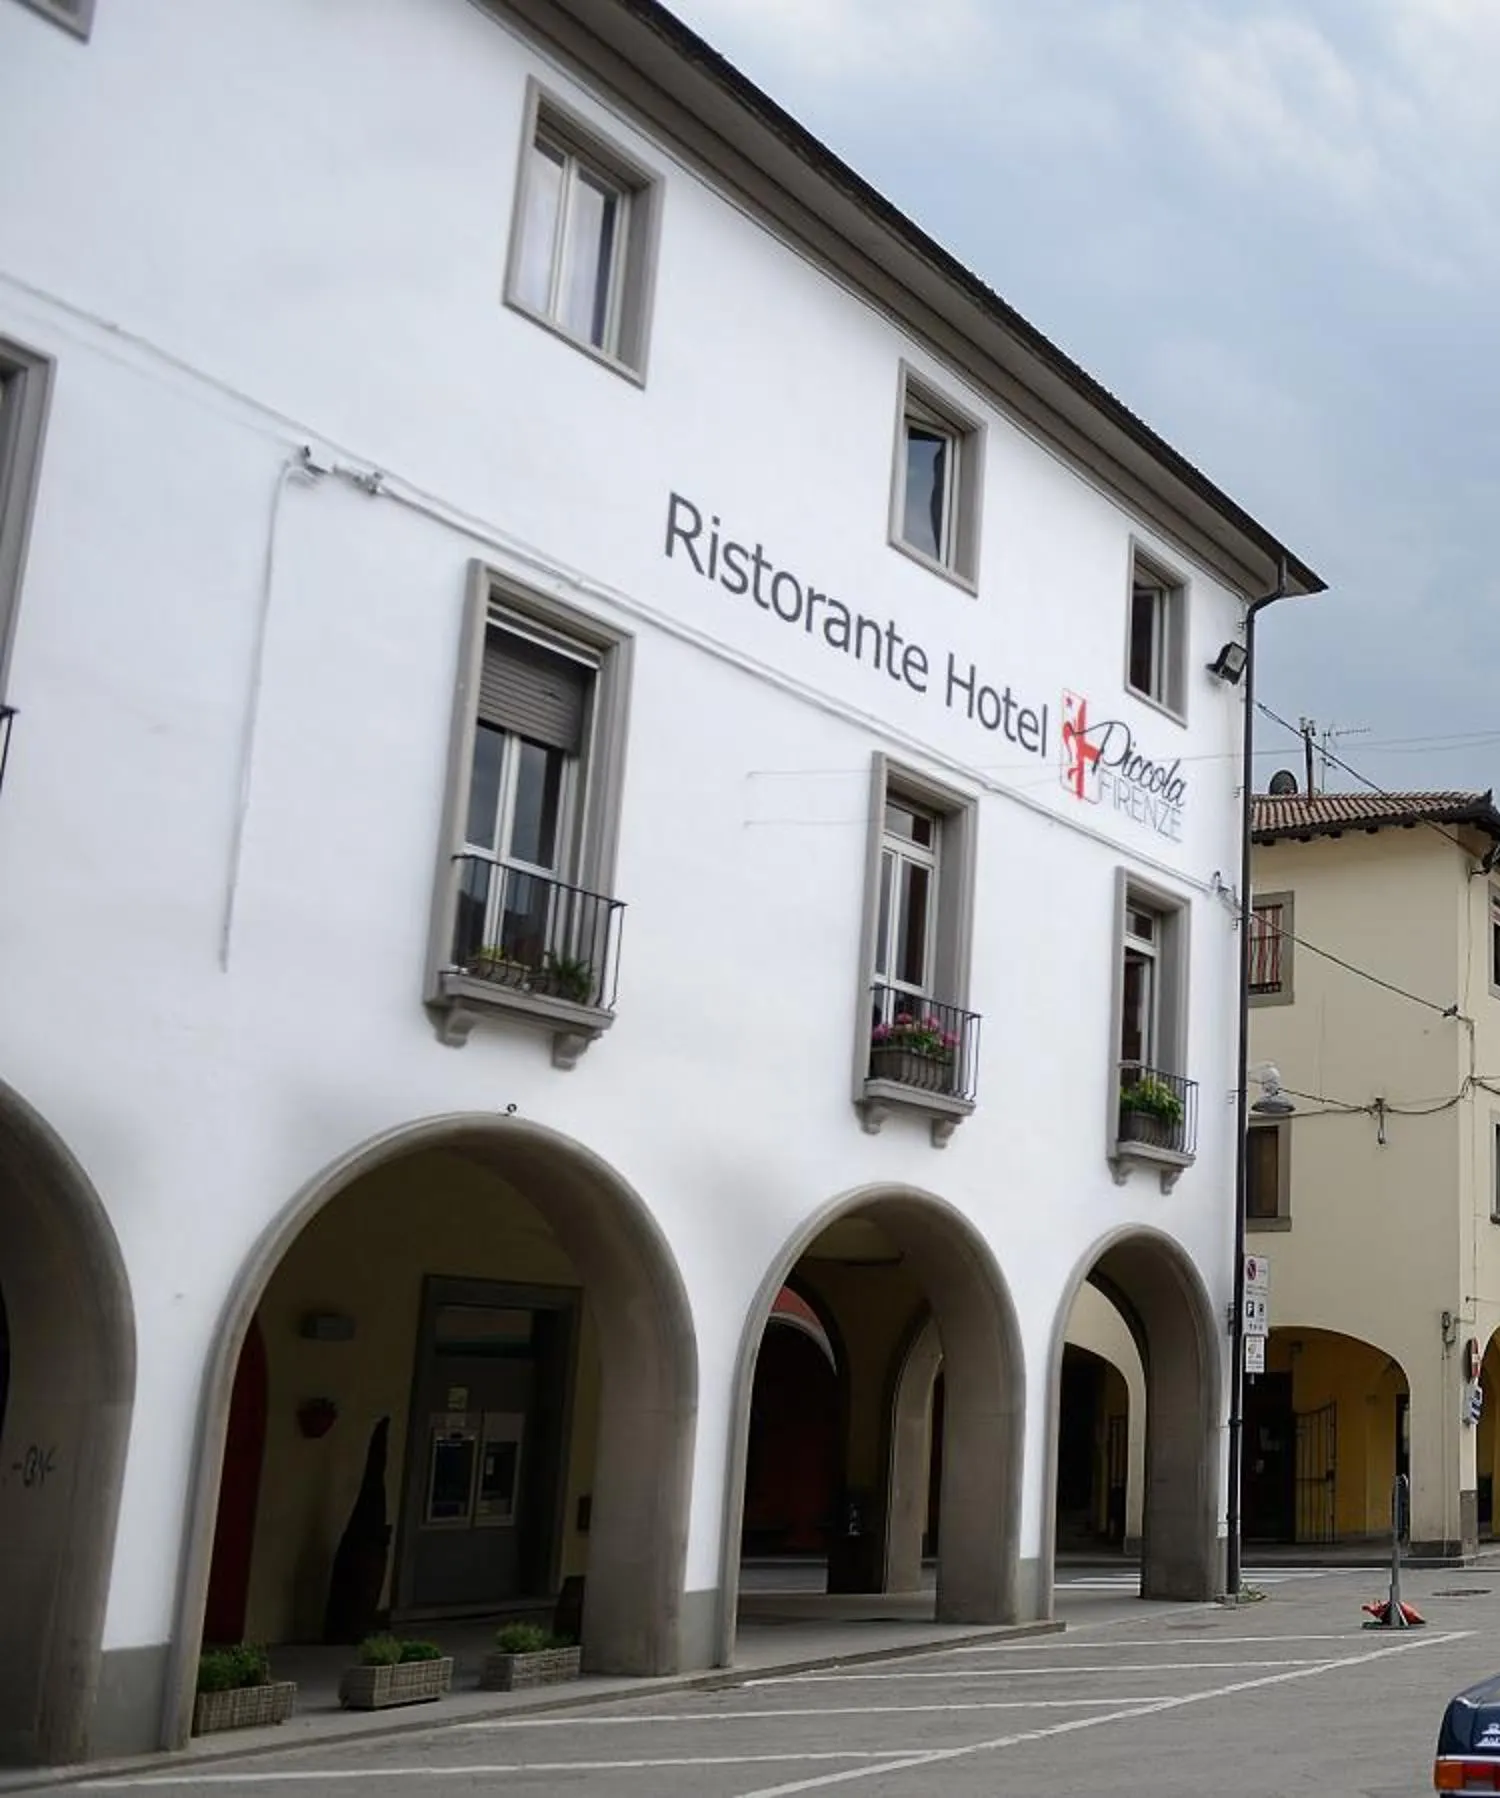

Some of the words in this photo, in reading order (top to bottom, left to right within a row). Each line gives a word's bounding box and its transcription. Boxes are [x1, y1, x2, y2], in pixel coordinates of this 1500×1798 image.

[664, 491, 929, 693] Ristorante
[945, 652, 1048, 758] Hotel
[1080, 720, 1187, 808] Piccola
[1099, 768, 1182, 843] FIRENZE
